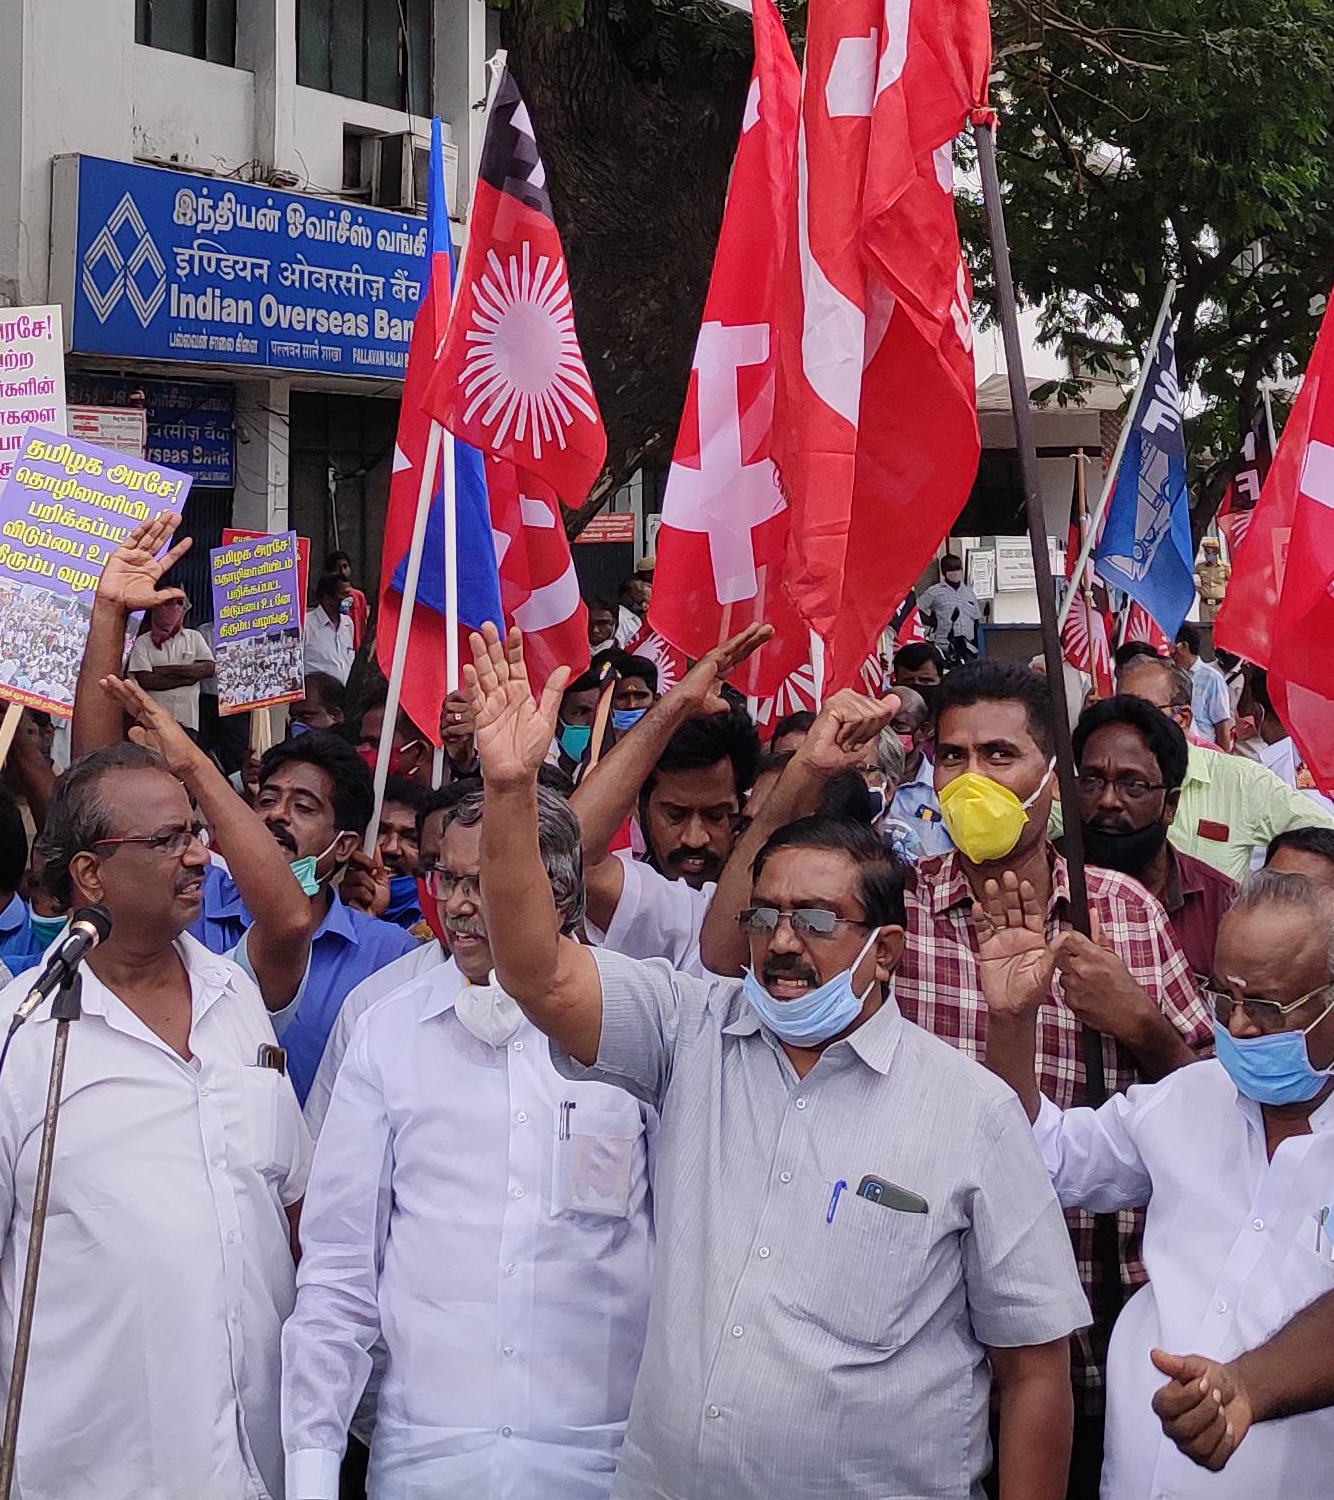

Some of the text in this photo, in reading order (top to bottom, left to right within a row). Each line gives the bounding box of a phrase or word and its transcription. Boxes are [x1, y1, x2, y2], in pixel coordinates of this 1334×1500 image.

[173, 186, 281, 235] இந்தியன்
[286, 202, 373, 248] ஓவர்சீஸ்
[173, 238, 271, 283] इण्डियन
[279, 252, 385, 302] ओवरसीज़
[170, 283, 414, 342] Indian Overseas Ban
[23, 438, 183, 504] தமிழக அரசே!
[2, 518, 85, 559] விடுப்பை
[28, 500, 132, 545] பறிக்கப்பட்
